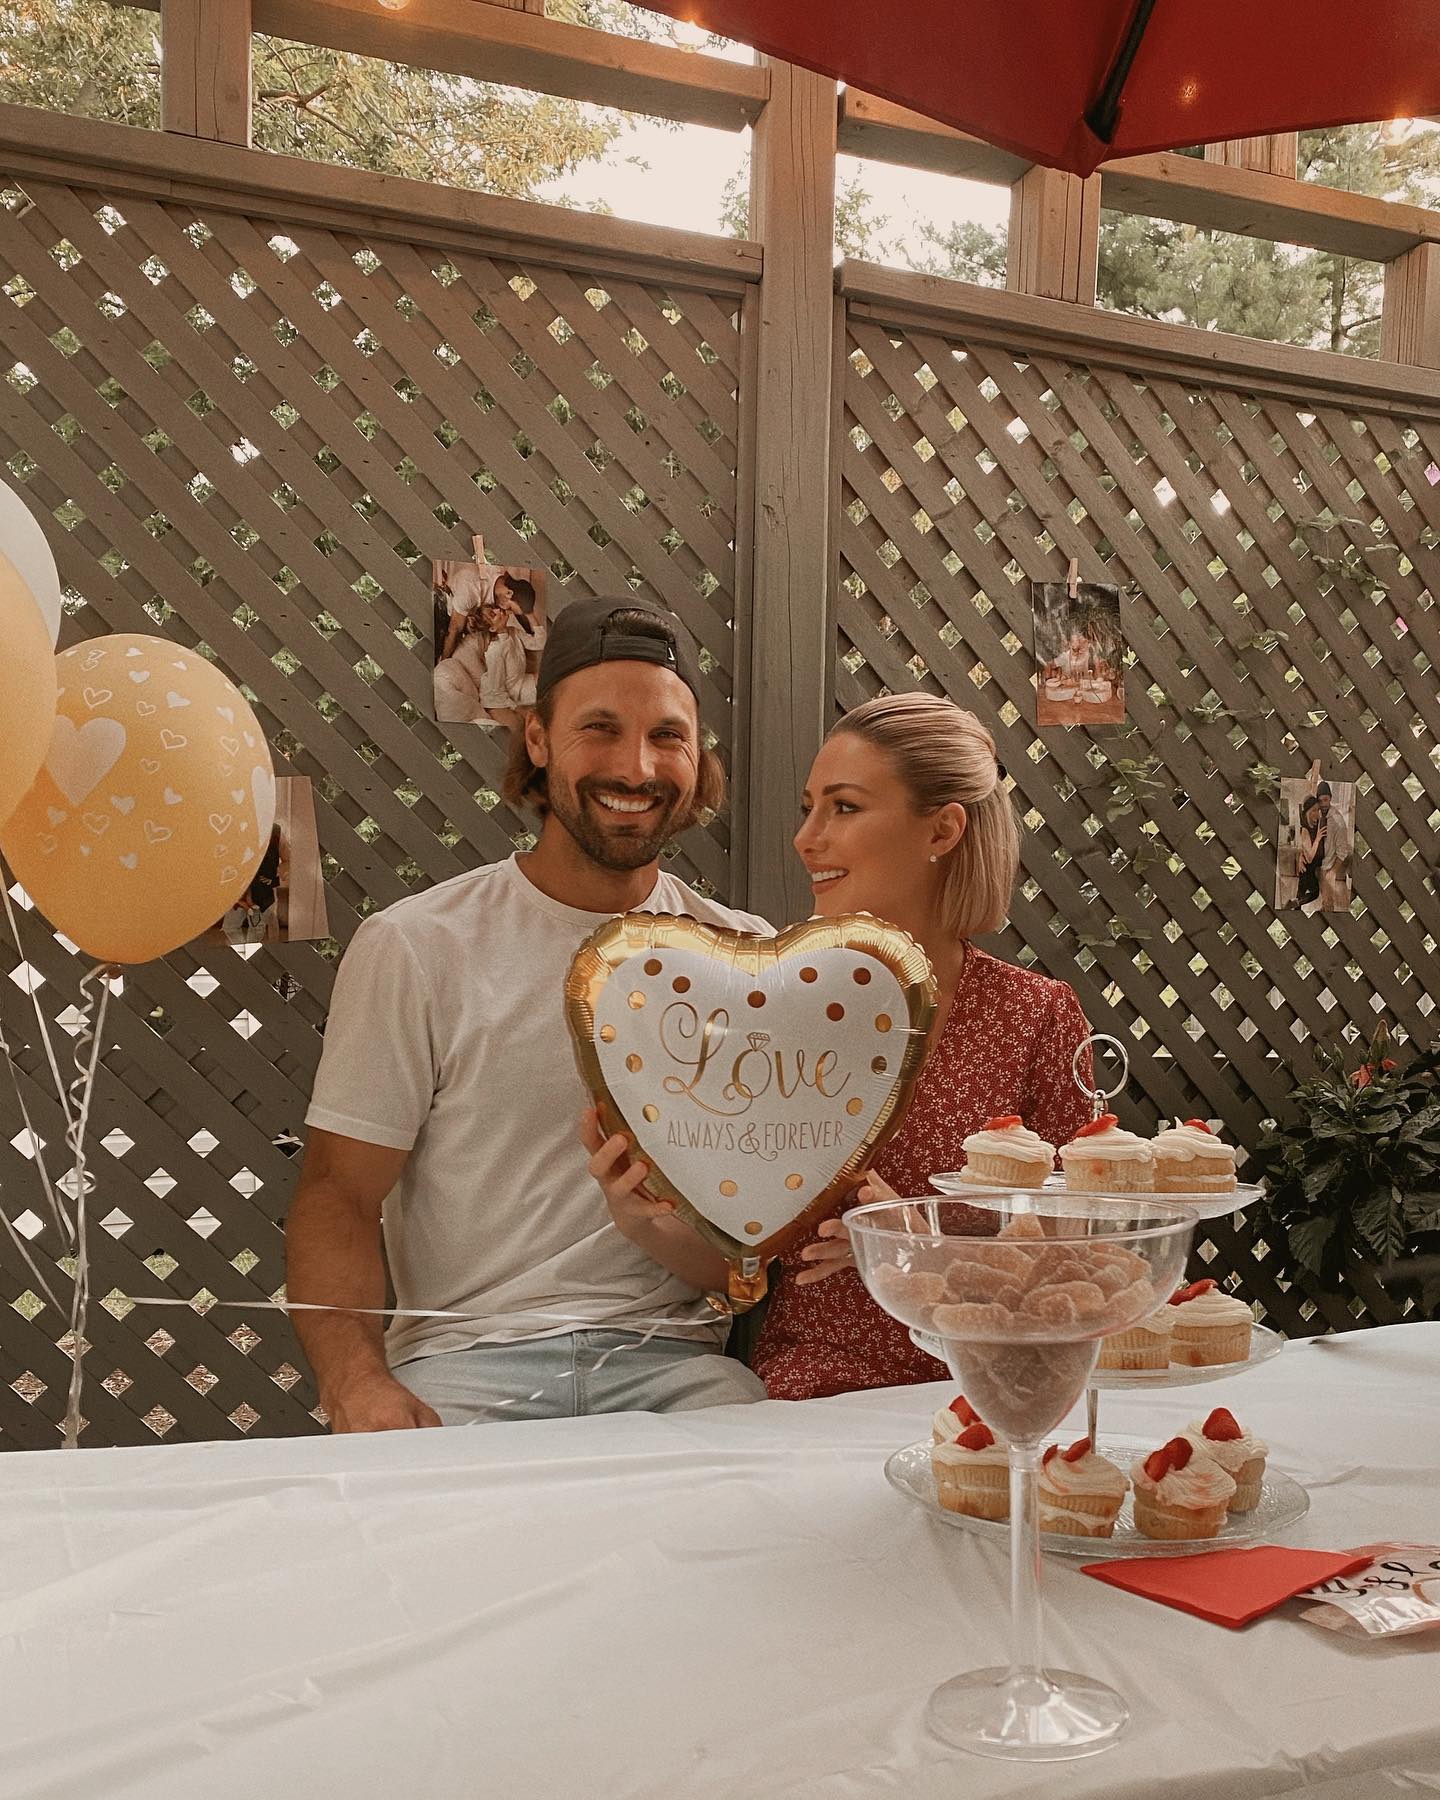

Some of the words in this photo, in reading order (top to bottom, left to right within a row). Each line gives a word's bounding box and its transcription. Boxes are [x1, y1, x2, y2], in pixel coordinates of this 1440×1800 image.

[660, 1001, 851, 1116] Love
[667, 1121, 735, 1151] ALWAYS
[738, 1122, 778, 1161] &
[765, 1120, 844, 1151] FOREVER
